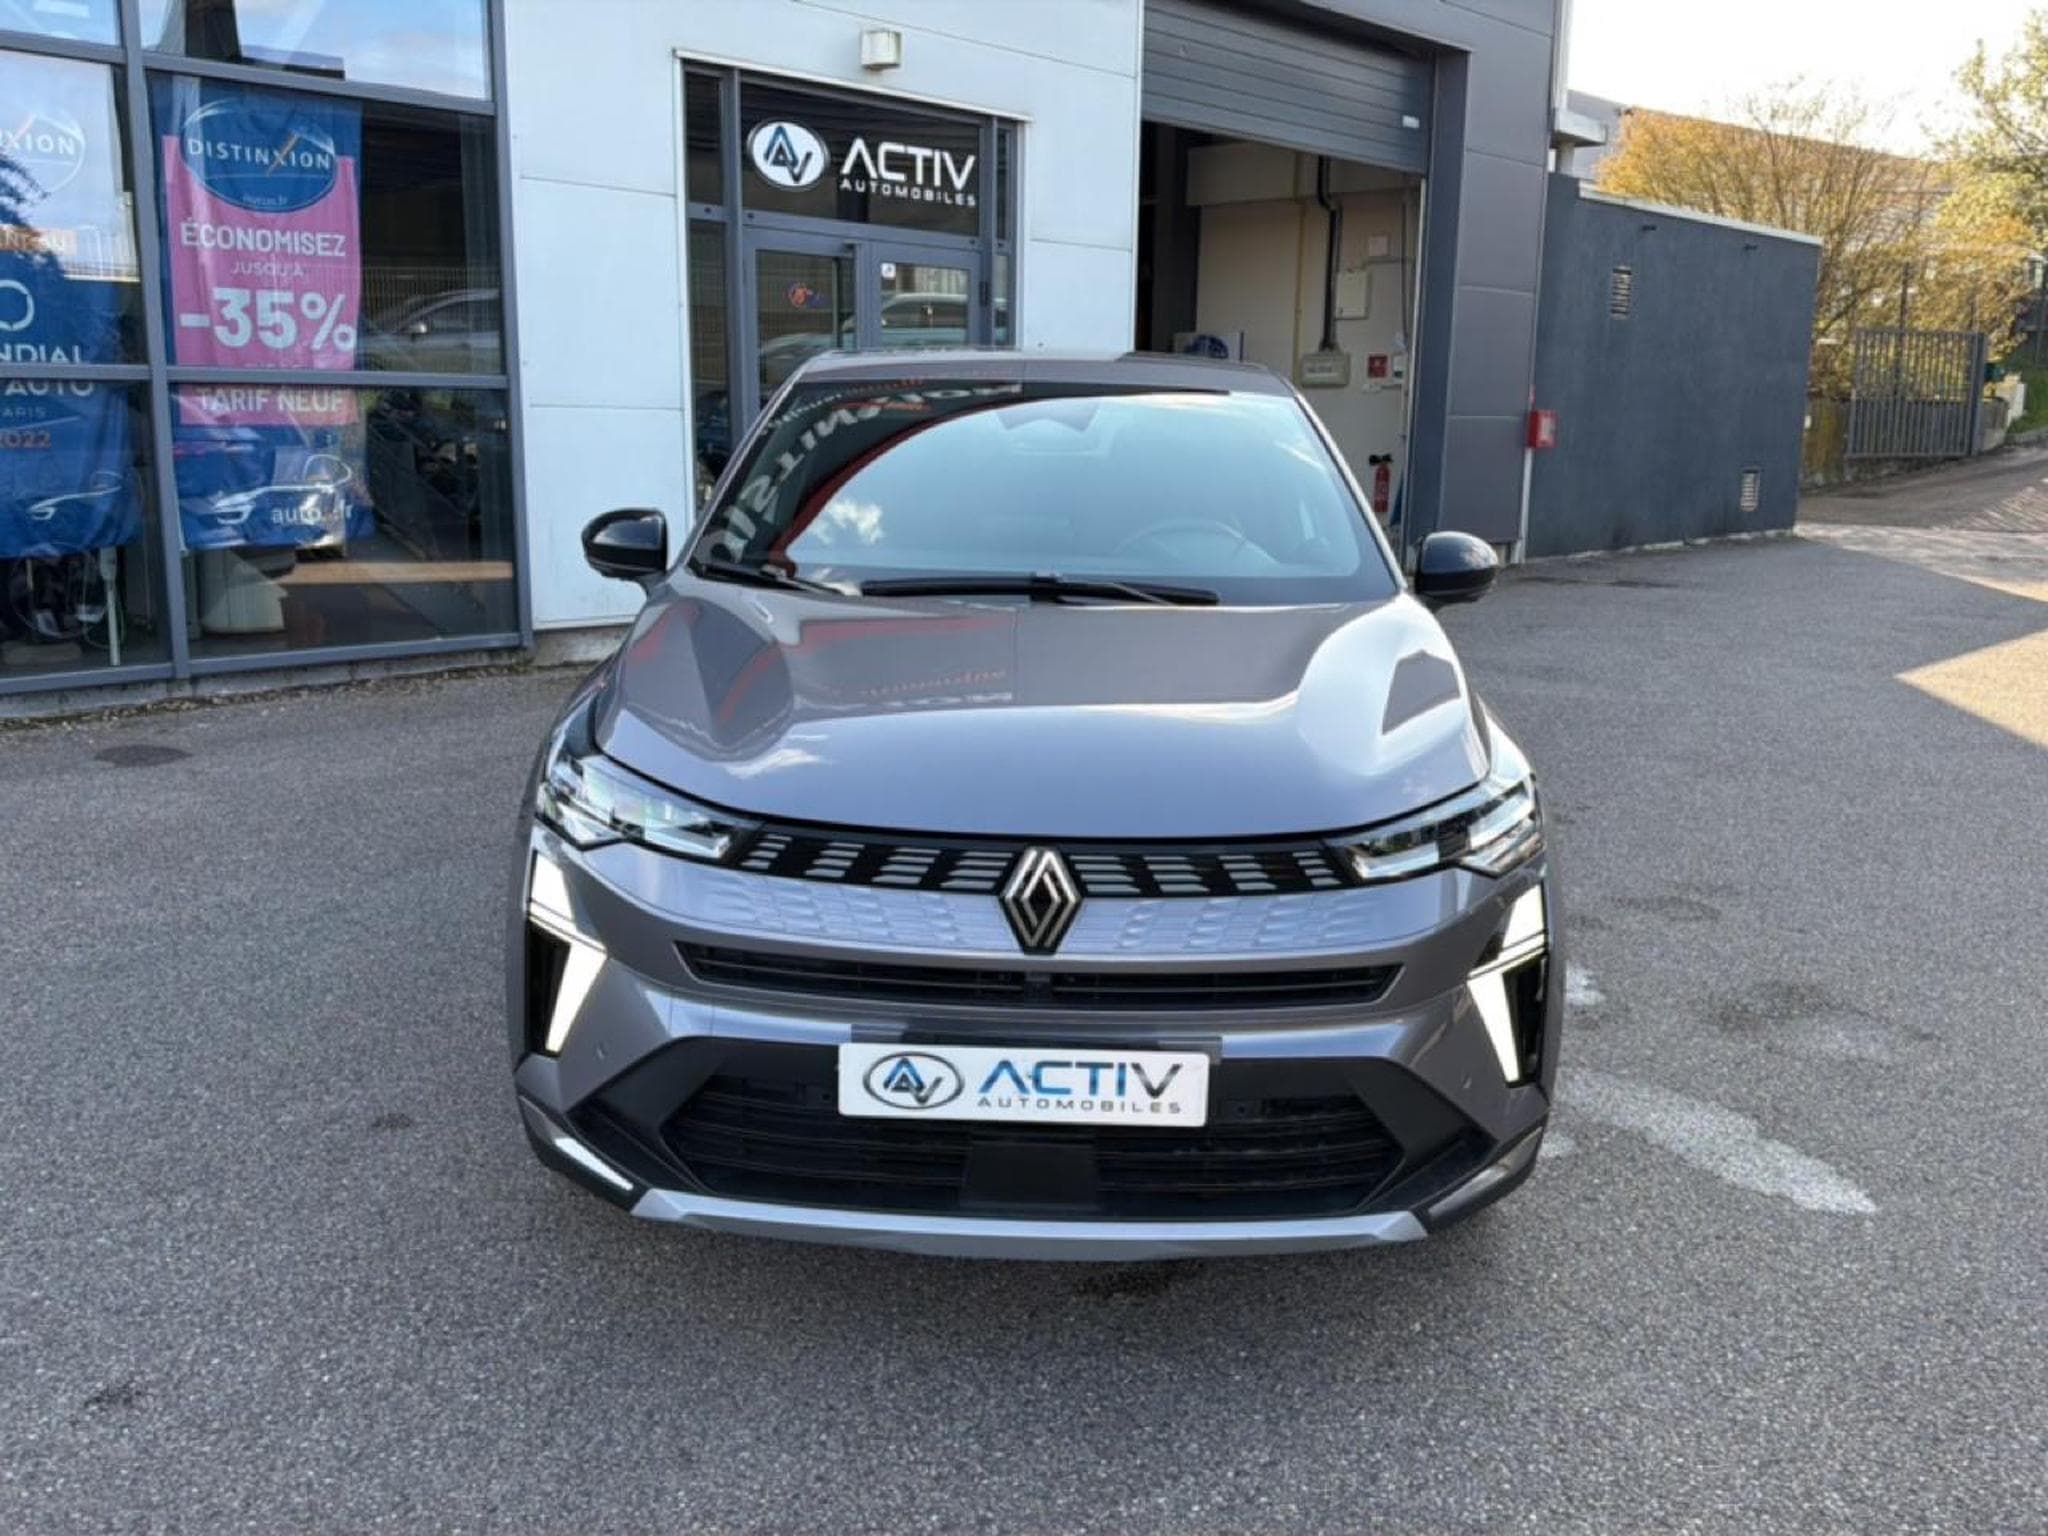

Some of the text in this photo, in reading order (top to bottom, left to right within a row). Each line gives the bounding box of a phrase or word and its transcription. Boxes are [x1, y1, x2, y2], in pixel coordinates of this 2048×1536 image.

[0, 131, 76, 156] XION
[186, 137, 331, 170] DISTINXION
[841, 138, 977, 191] ACTIV
[840, 177, 977, 208] AUTOMOBILES
[180, 216, 347, 257] ÉCONOMISEZ
[179, 286, 358, 352] -35%
[196, 387, 345, 414] TARIF NEUF
[978, 1059, 1183, 1099] ACTIV
[977, 1096, 1182, 1114] AUTOMOBILES
